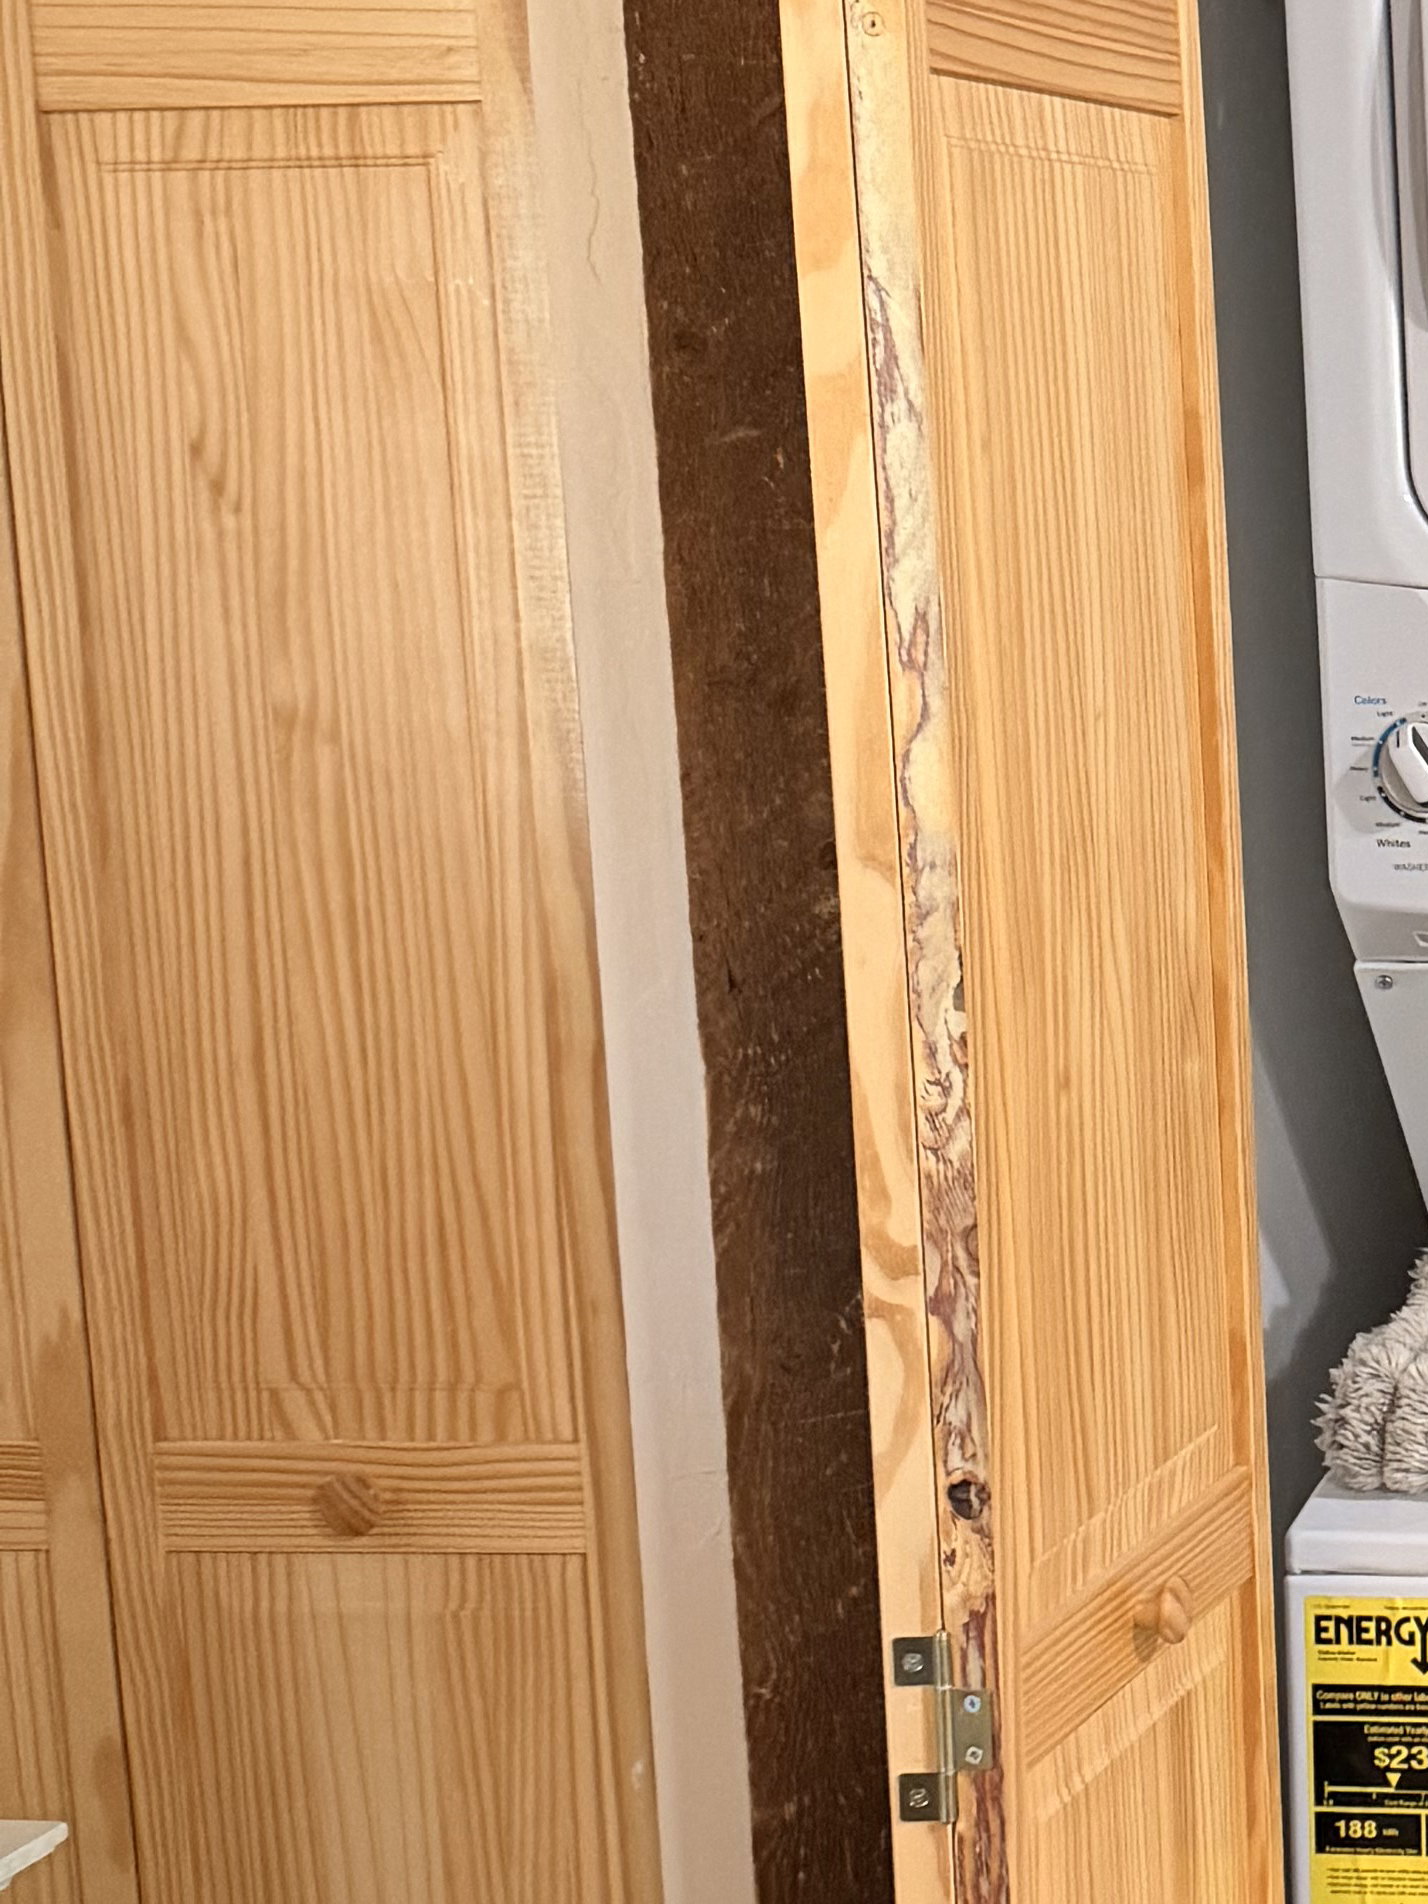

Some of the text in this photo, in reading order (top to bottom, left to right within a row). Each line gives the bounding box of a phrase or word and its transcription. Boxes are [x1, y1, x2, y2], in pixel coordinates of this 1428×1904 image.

[1354, 696, 1386, 705] Colors
[1377, 839, 1411, 848] Whites
[1316, 1690, 1354, 1701] Compare
[1356, 1691, 1378, 1700] ONLY
[1391, 1692, 1412, 1702] other
[1364, 1725, 1404, 1736] Estimated
[1334, 1820, 1377, 1838] 188
